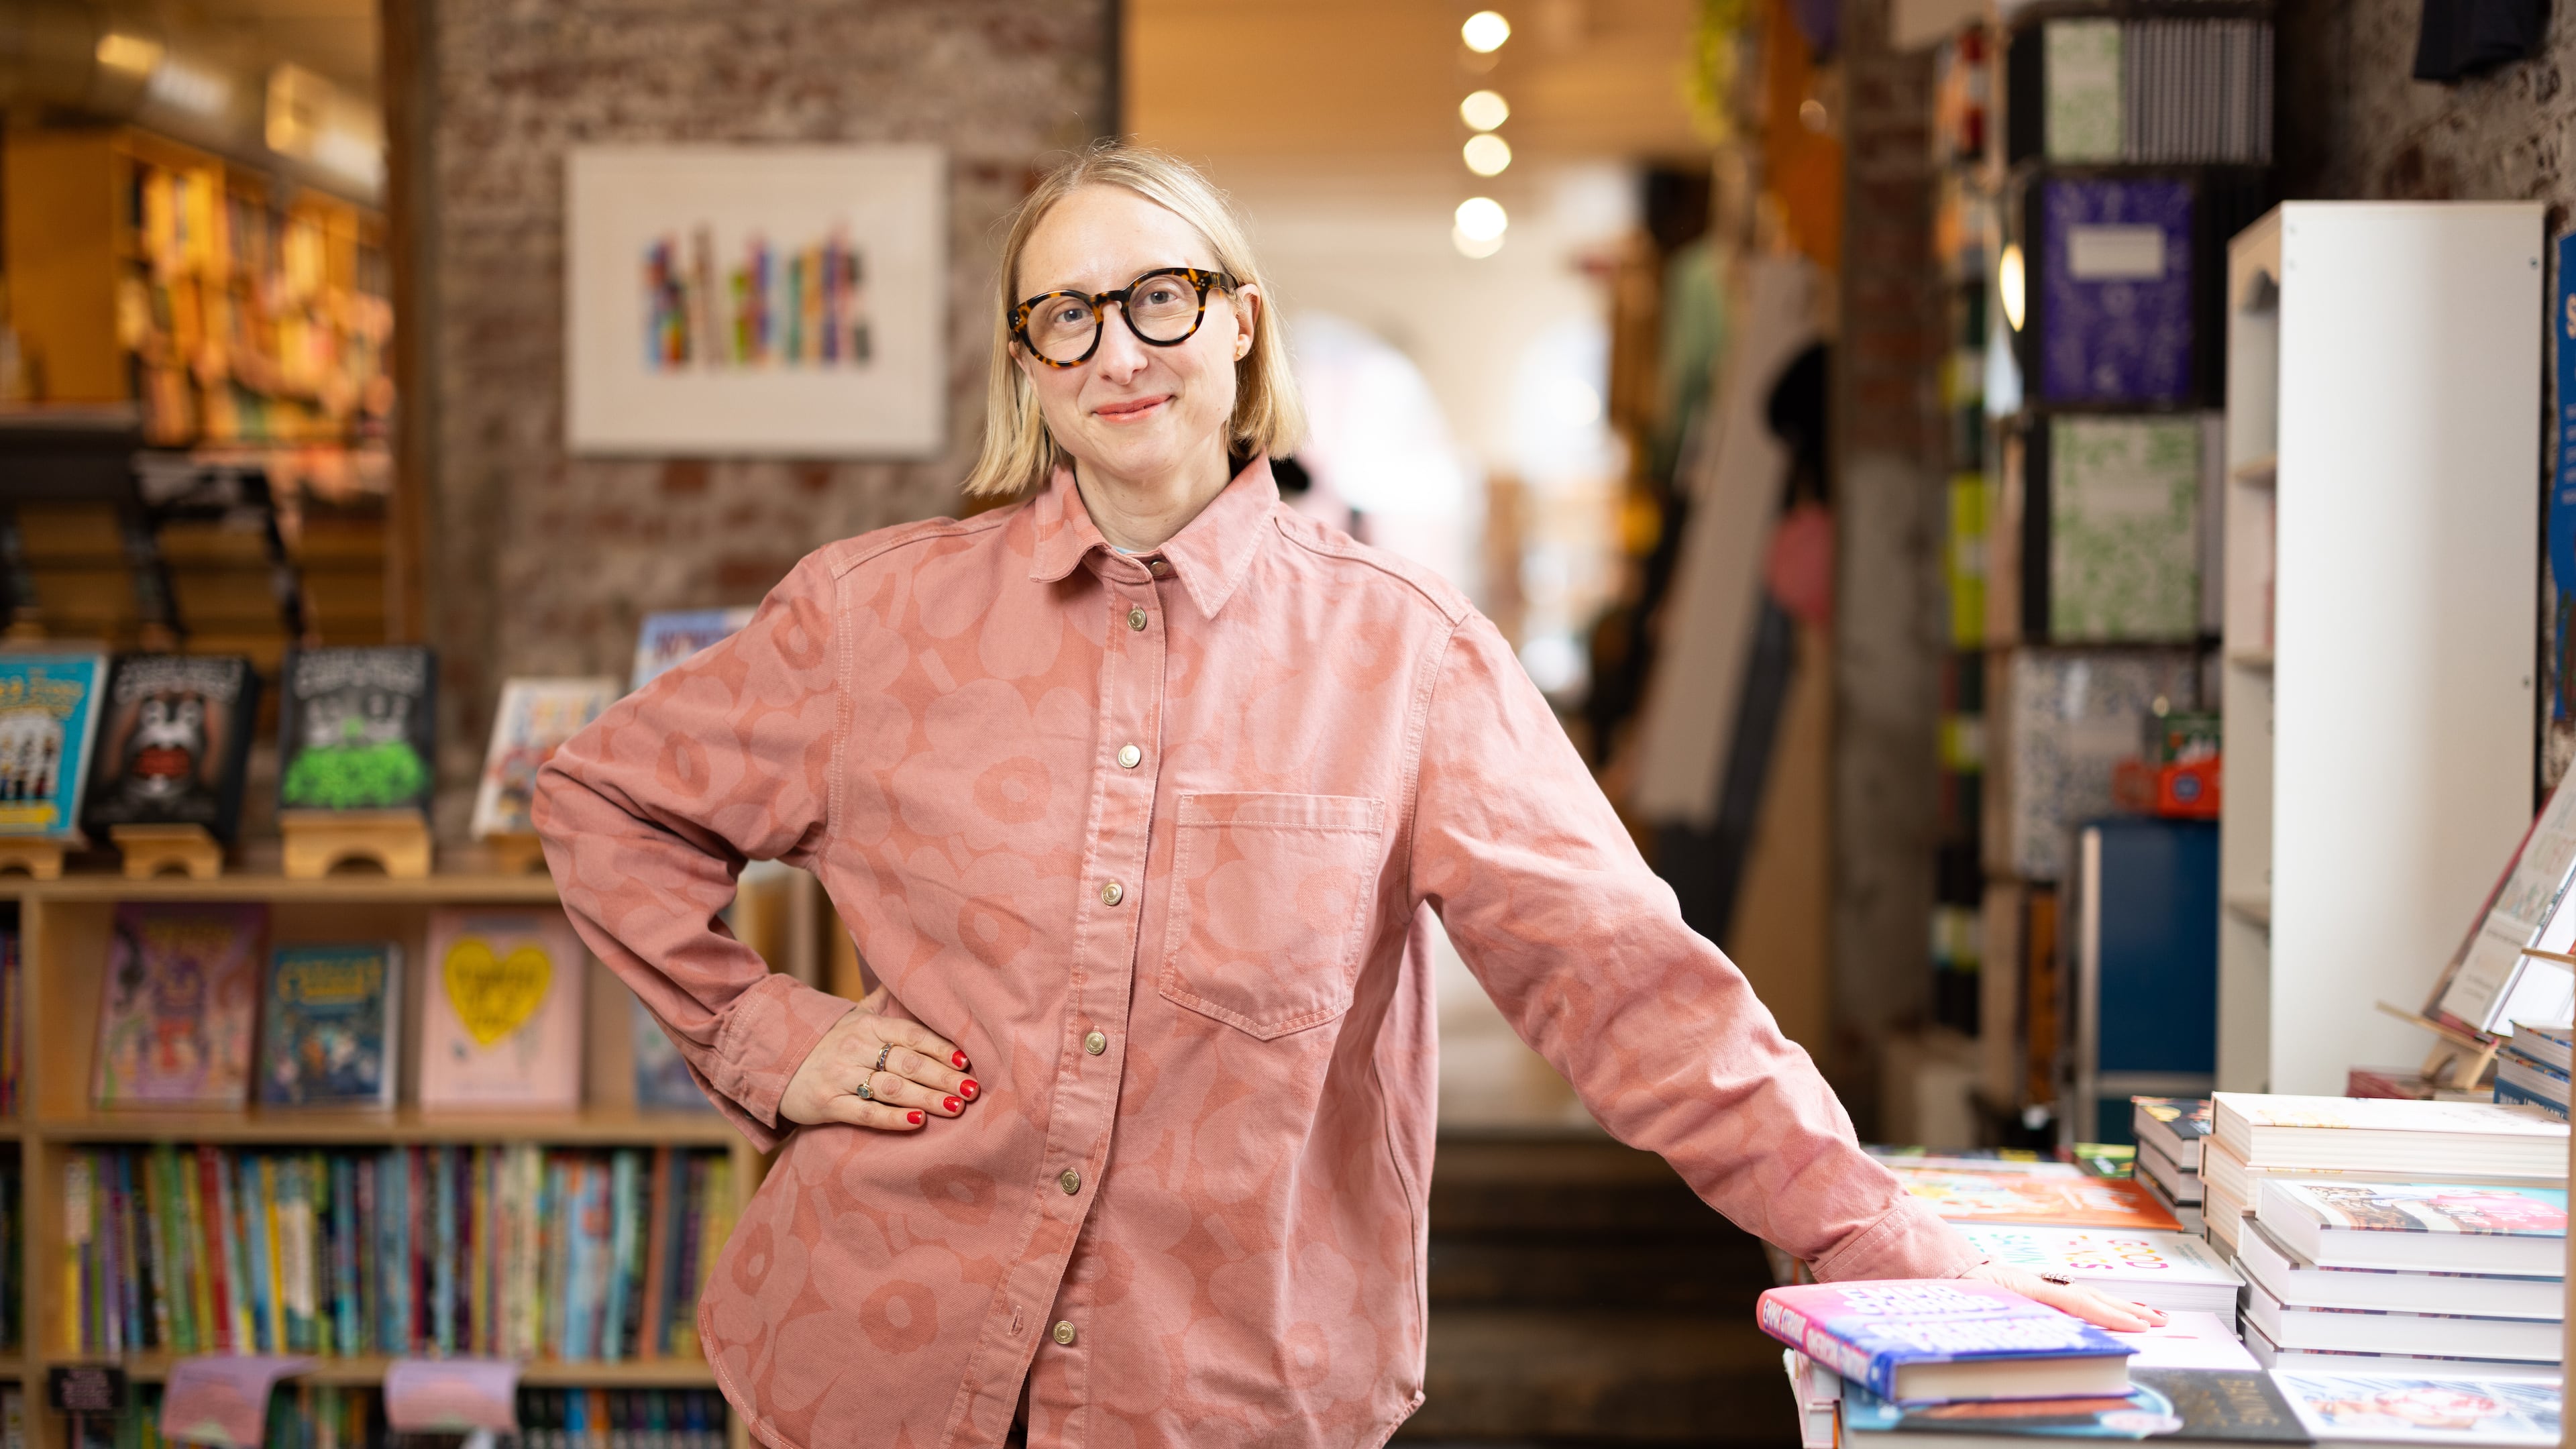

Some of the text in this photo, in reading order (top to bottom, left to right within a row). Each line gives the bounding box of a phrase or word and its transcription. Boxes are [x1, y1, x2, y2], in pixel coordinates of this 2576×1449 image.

[2107, 1238, 2169, 1269] GOOD
[1836, 1285, 1965, 1301] EMMA
[1843, 1295, 2010, 1316] STRAUB
[1762, 1299, 1784, 1330] EMMA
